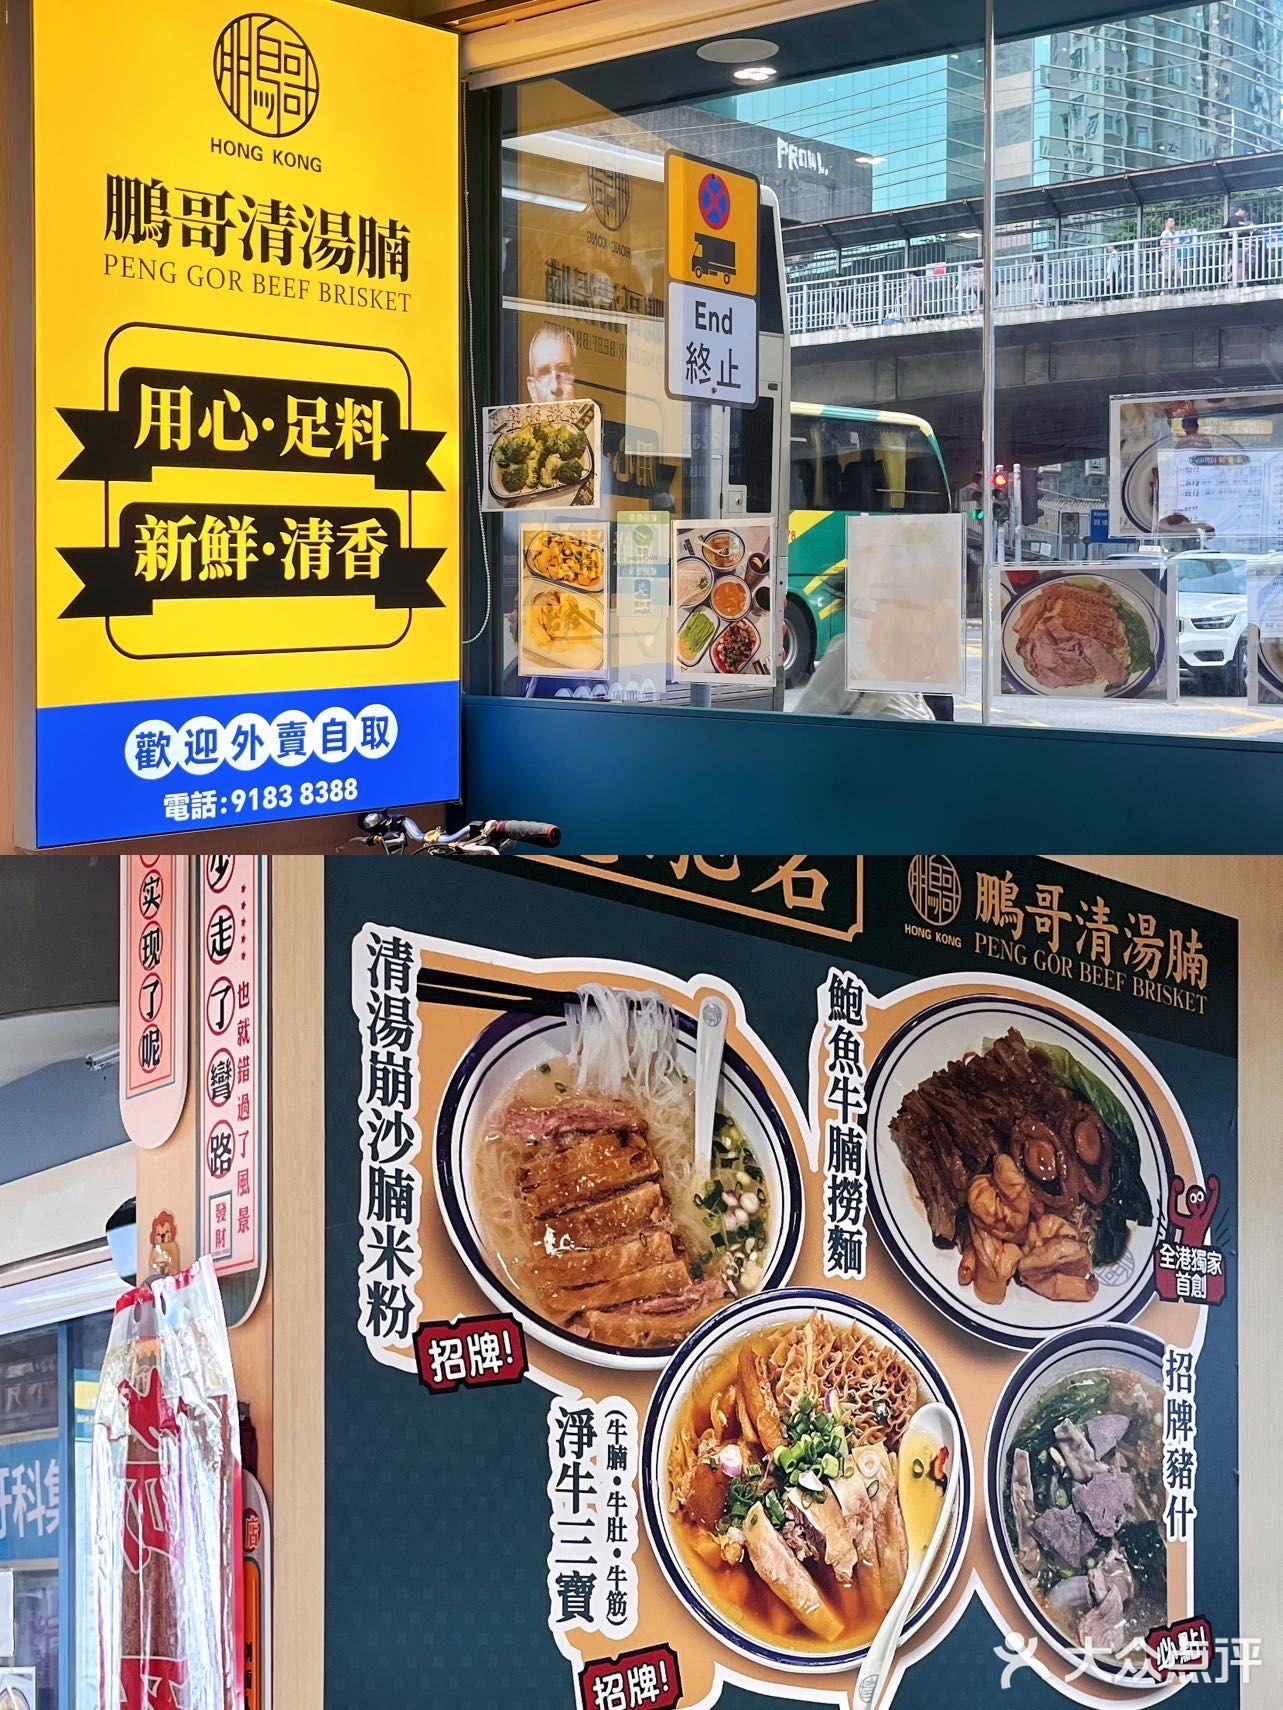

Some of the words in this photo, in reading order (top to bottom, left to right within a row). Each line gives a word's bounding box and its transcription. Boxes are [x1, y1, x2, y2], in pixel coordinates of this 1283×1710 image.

[210, 136, 263, 163] HONG
[272, 149, 322, 173] KONG
[104, 172, 411, 283] 鵬哥清湯腩
[104, 253, 176, 284] PENG
[187, 264, 243, 292] GOR
[252, 273, 311, 300] BEEF
[318, 282, 412, 313] BRISKET
[695, 301, 733, 336] End
[685, 341, 741, 390] 終止
[135, 715, 391, 772] 歡迎外賣自取
[300, 777, 358, 805] 8388
[905, 923, 932, 942] HONG
[935, 931, 961, 949] KONG
[976, 870, 1209, 991] 鵬哥清湯腩
[975, 932, 1027, 966] PENG
[1033, 949, 1072, 978] GOR
[1080, 962, 1125, 993] BEEF
[1133, 977, 1207, 1015] BRISKET
[237, 981, 250, 1233] 也就錯過了風景
[367, 931, 414, 1337] 清湯崩沙腩米粉
[828, 973, 863, 1275] 鮑魚牛腩撈麵
[216, 1202, 226, 1249] 發財
[1160, 1243, 1222, 1275] 全港獨家
[1176, 1271, 1207, 1298] 首創
[1167, 1349, 1194, 1538] 招牌豬什
[556, 1406, 597, 1623] 淨牛三寶
